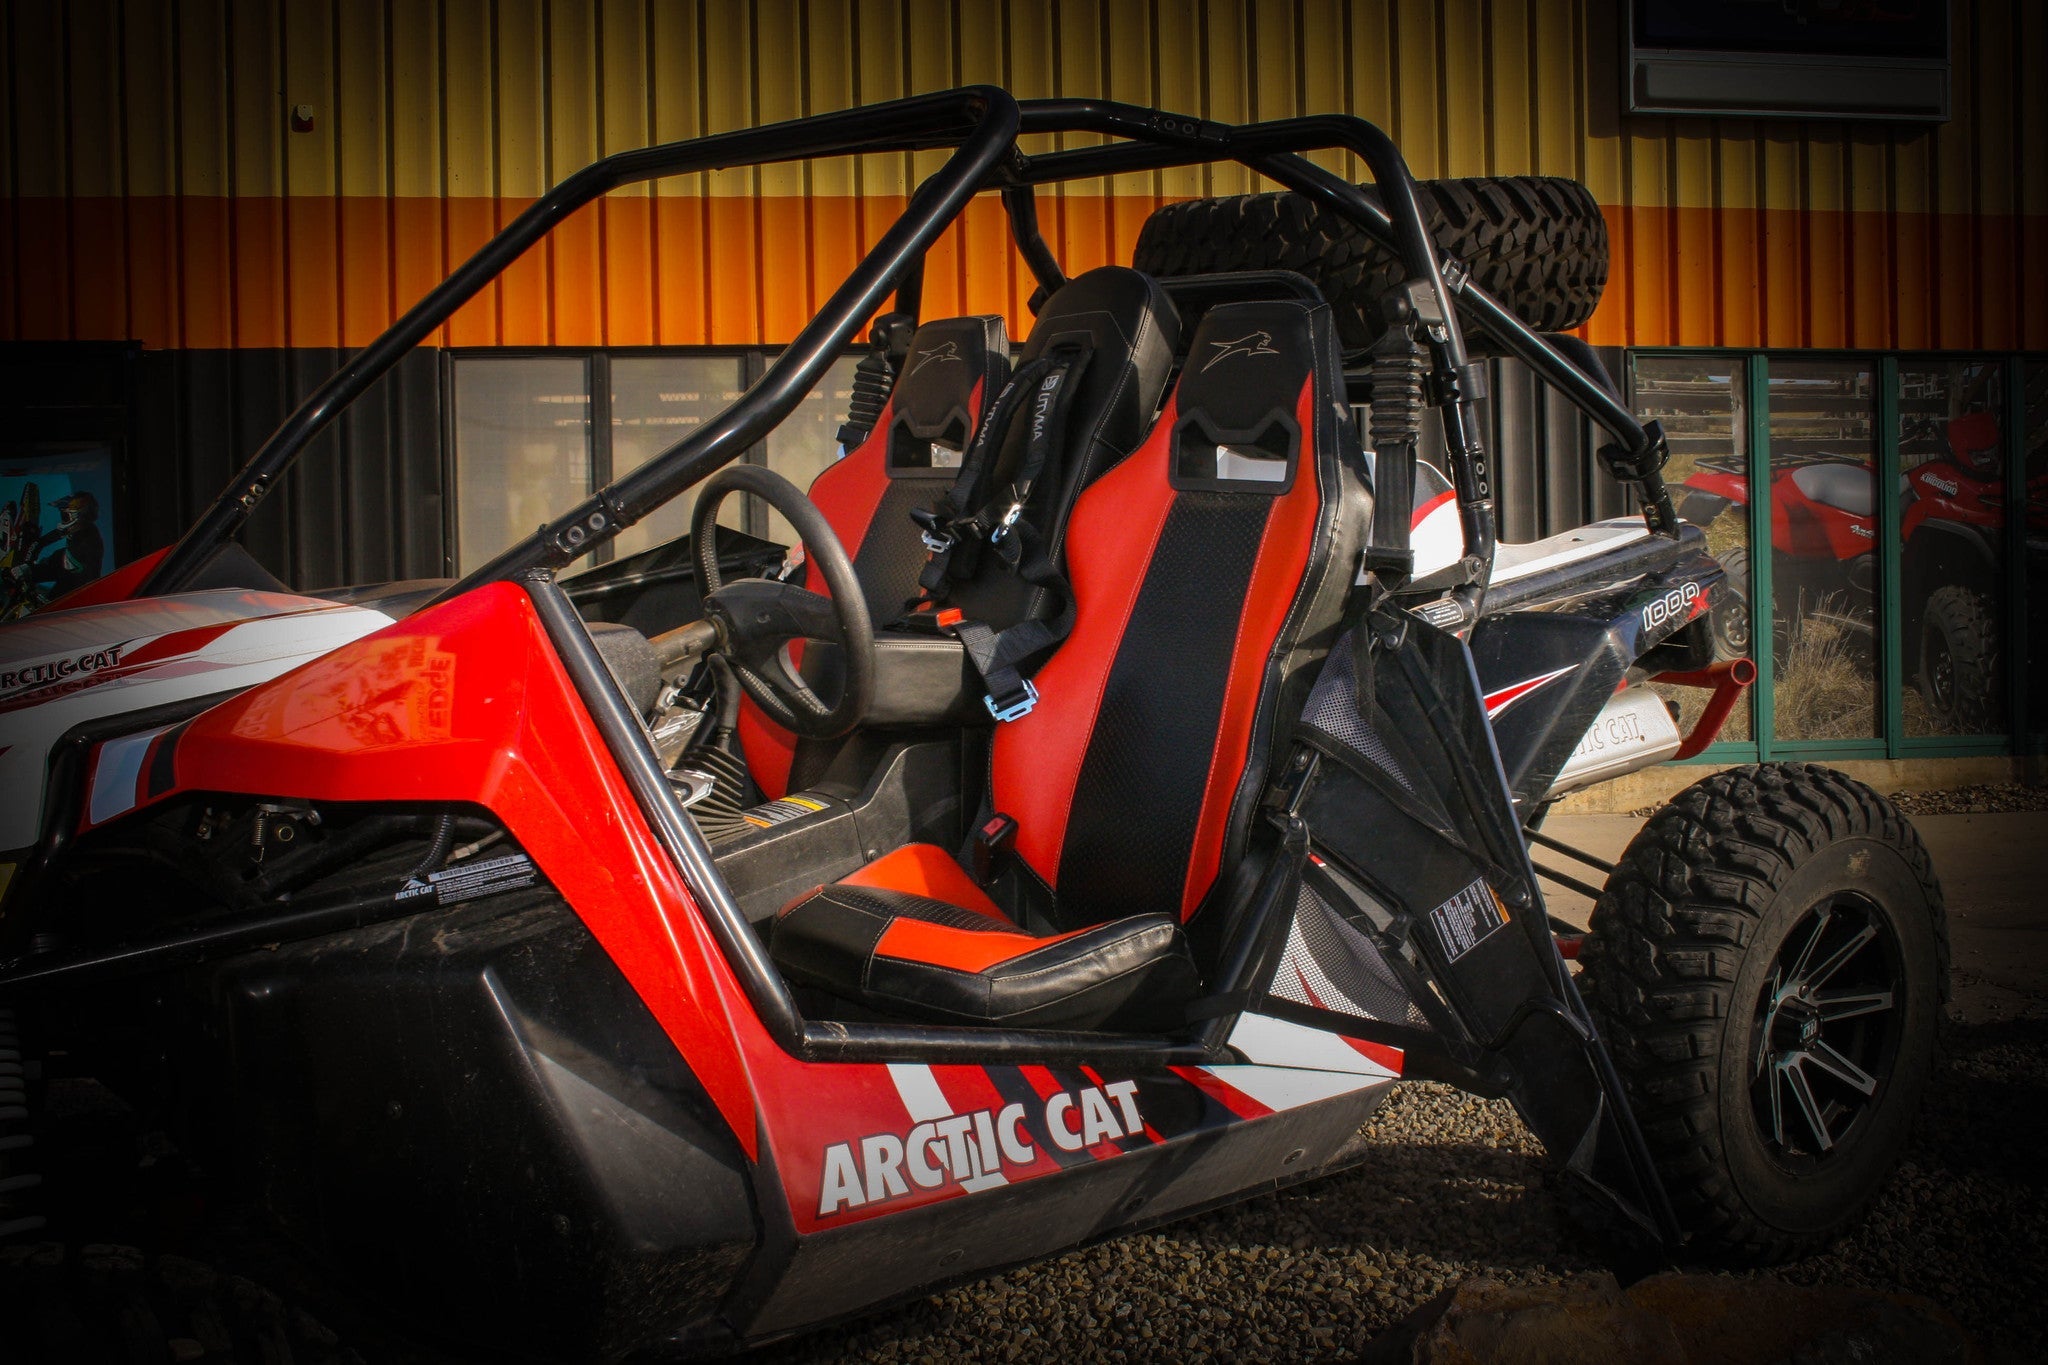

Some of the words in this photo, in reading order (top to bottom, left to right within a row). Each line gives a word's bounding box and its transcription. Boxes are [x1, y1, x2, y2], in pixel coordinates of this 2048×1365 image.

[0, 659, 72, 690] RCTIC
[77, 648, 123, 673] CAT
[395, 888, 419, 900] ARCTIC
[420, 885, 435, 895] CAT
[817, 1102, 1035, 1216] ARCTIC
[1045, 1079, 1145, 1151] CAT
